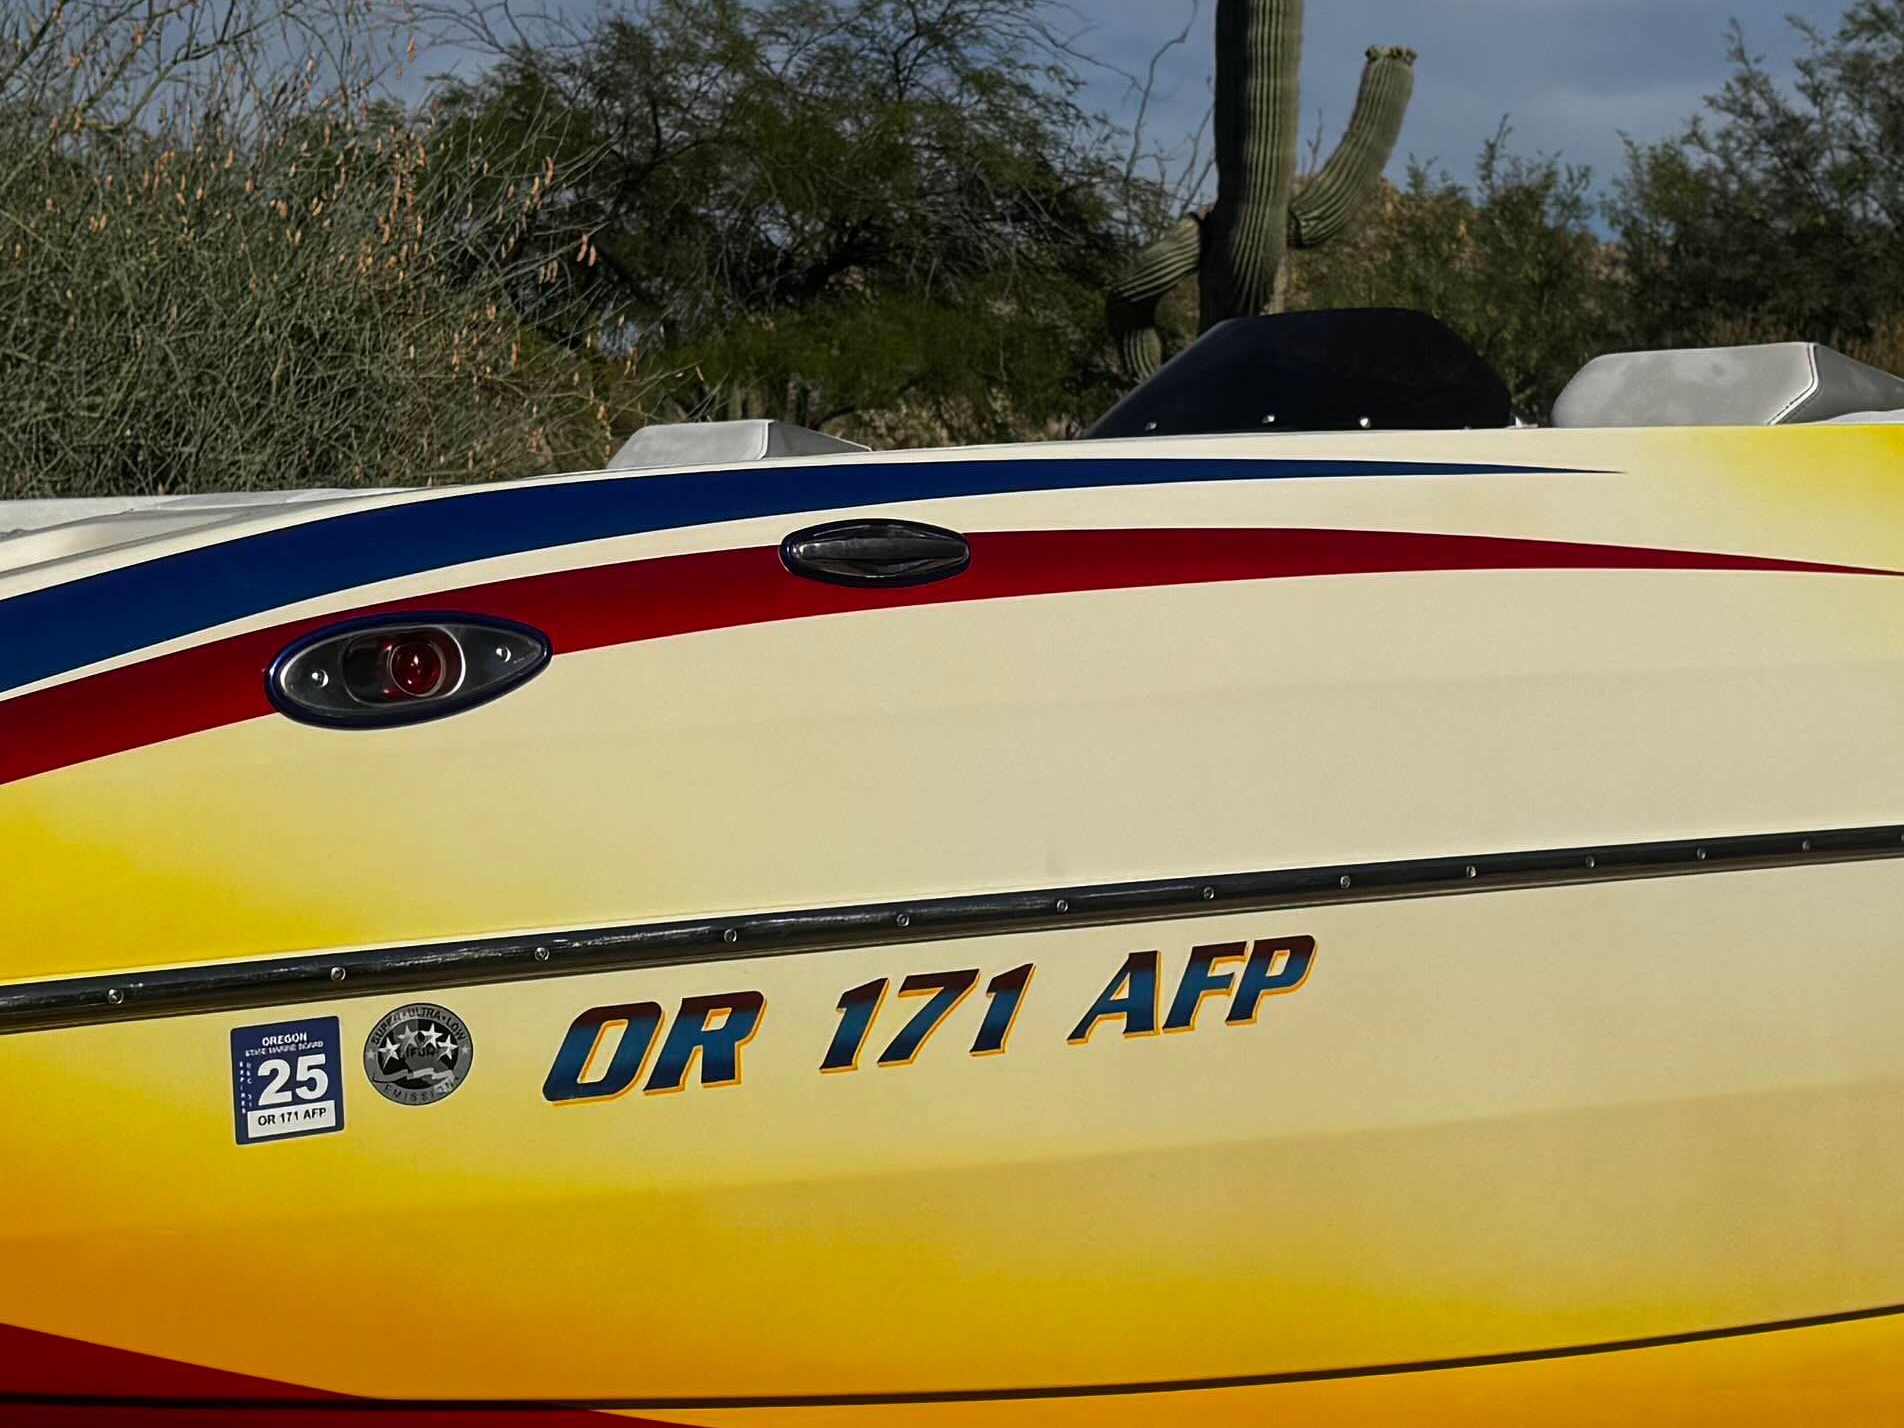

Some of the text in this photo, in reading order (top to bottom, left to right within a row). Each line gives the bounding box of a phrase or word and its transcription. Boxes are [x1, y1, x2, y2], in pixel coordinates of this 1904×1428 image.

[444, 1016, 467, 1042] LOW
[541, 934, 1317, 1106] OR 171 AFP
[261, 1031, 309, 1047] OREGON
[257, 1053, 329, 1106] 25
[257, 1107, 327, 1126] OR 171 AFP
